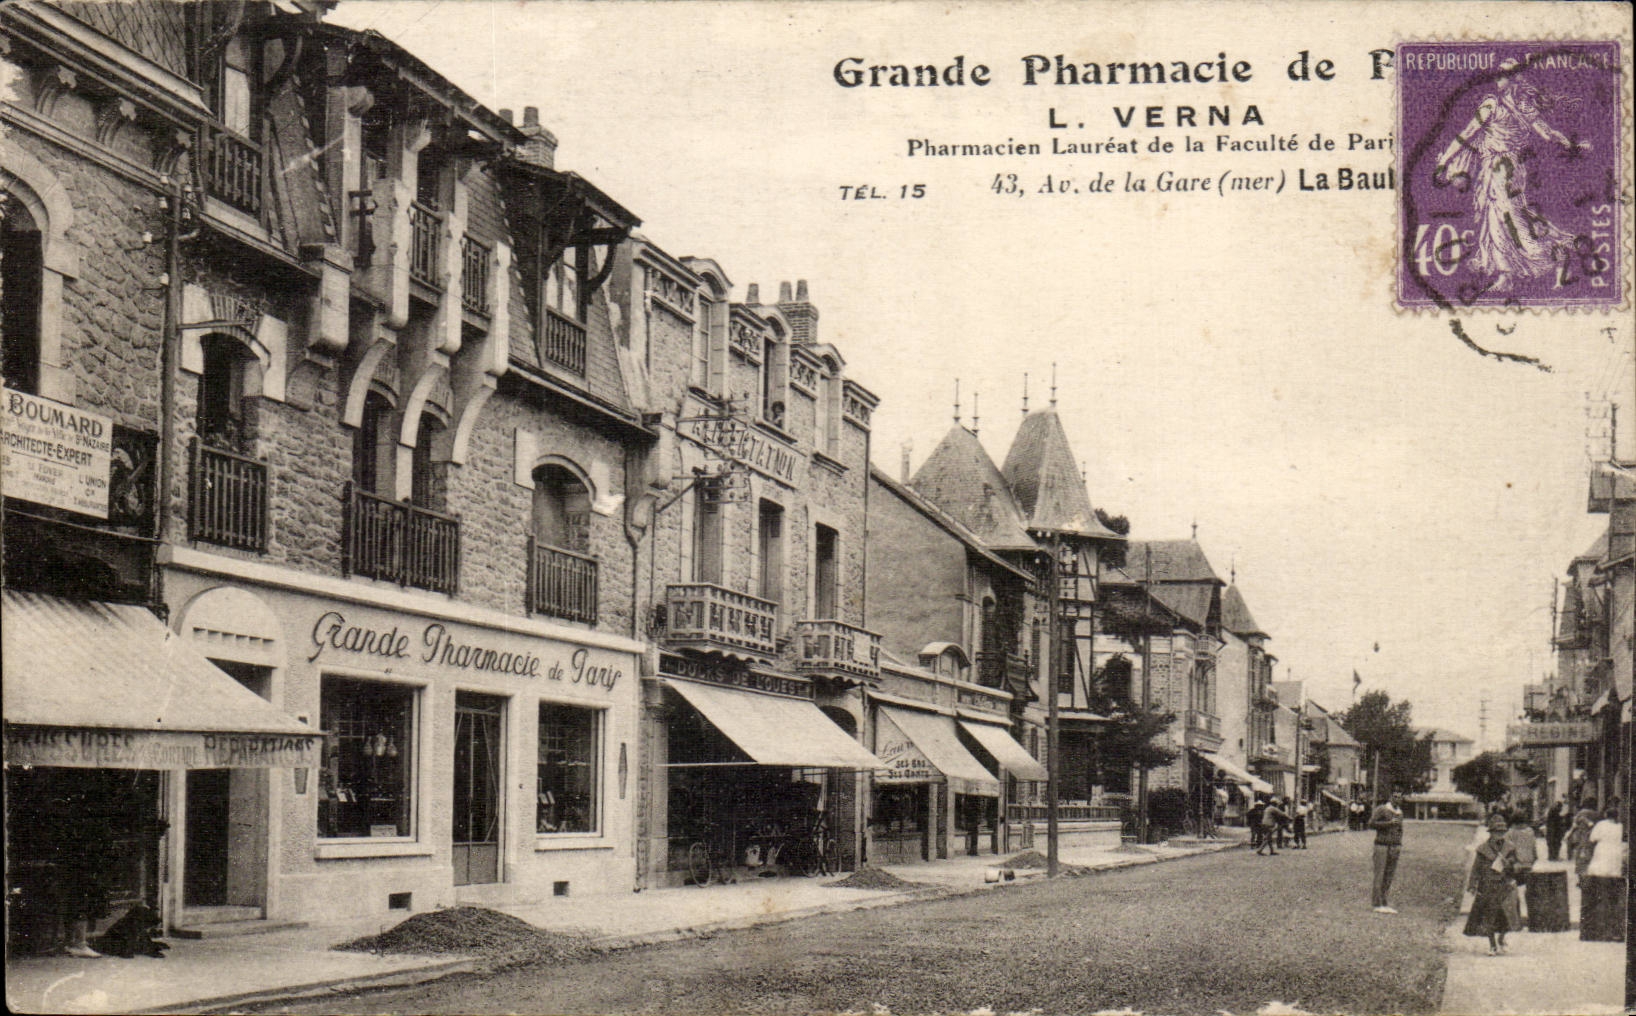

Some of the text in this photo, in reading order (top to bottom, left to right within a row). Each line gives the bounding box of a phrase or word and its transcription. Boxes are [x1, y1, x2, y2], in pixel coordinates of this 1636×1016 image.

[1591, 203, 1612, 288] POSTES
[8, 392, 103, 438] BOUMARD
[308, 611, 622, 691] Grande Pharmacie de Paris
[732, 671, 749, 687] DE
